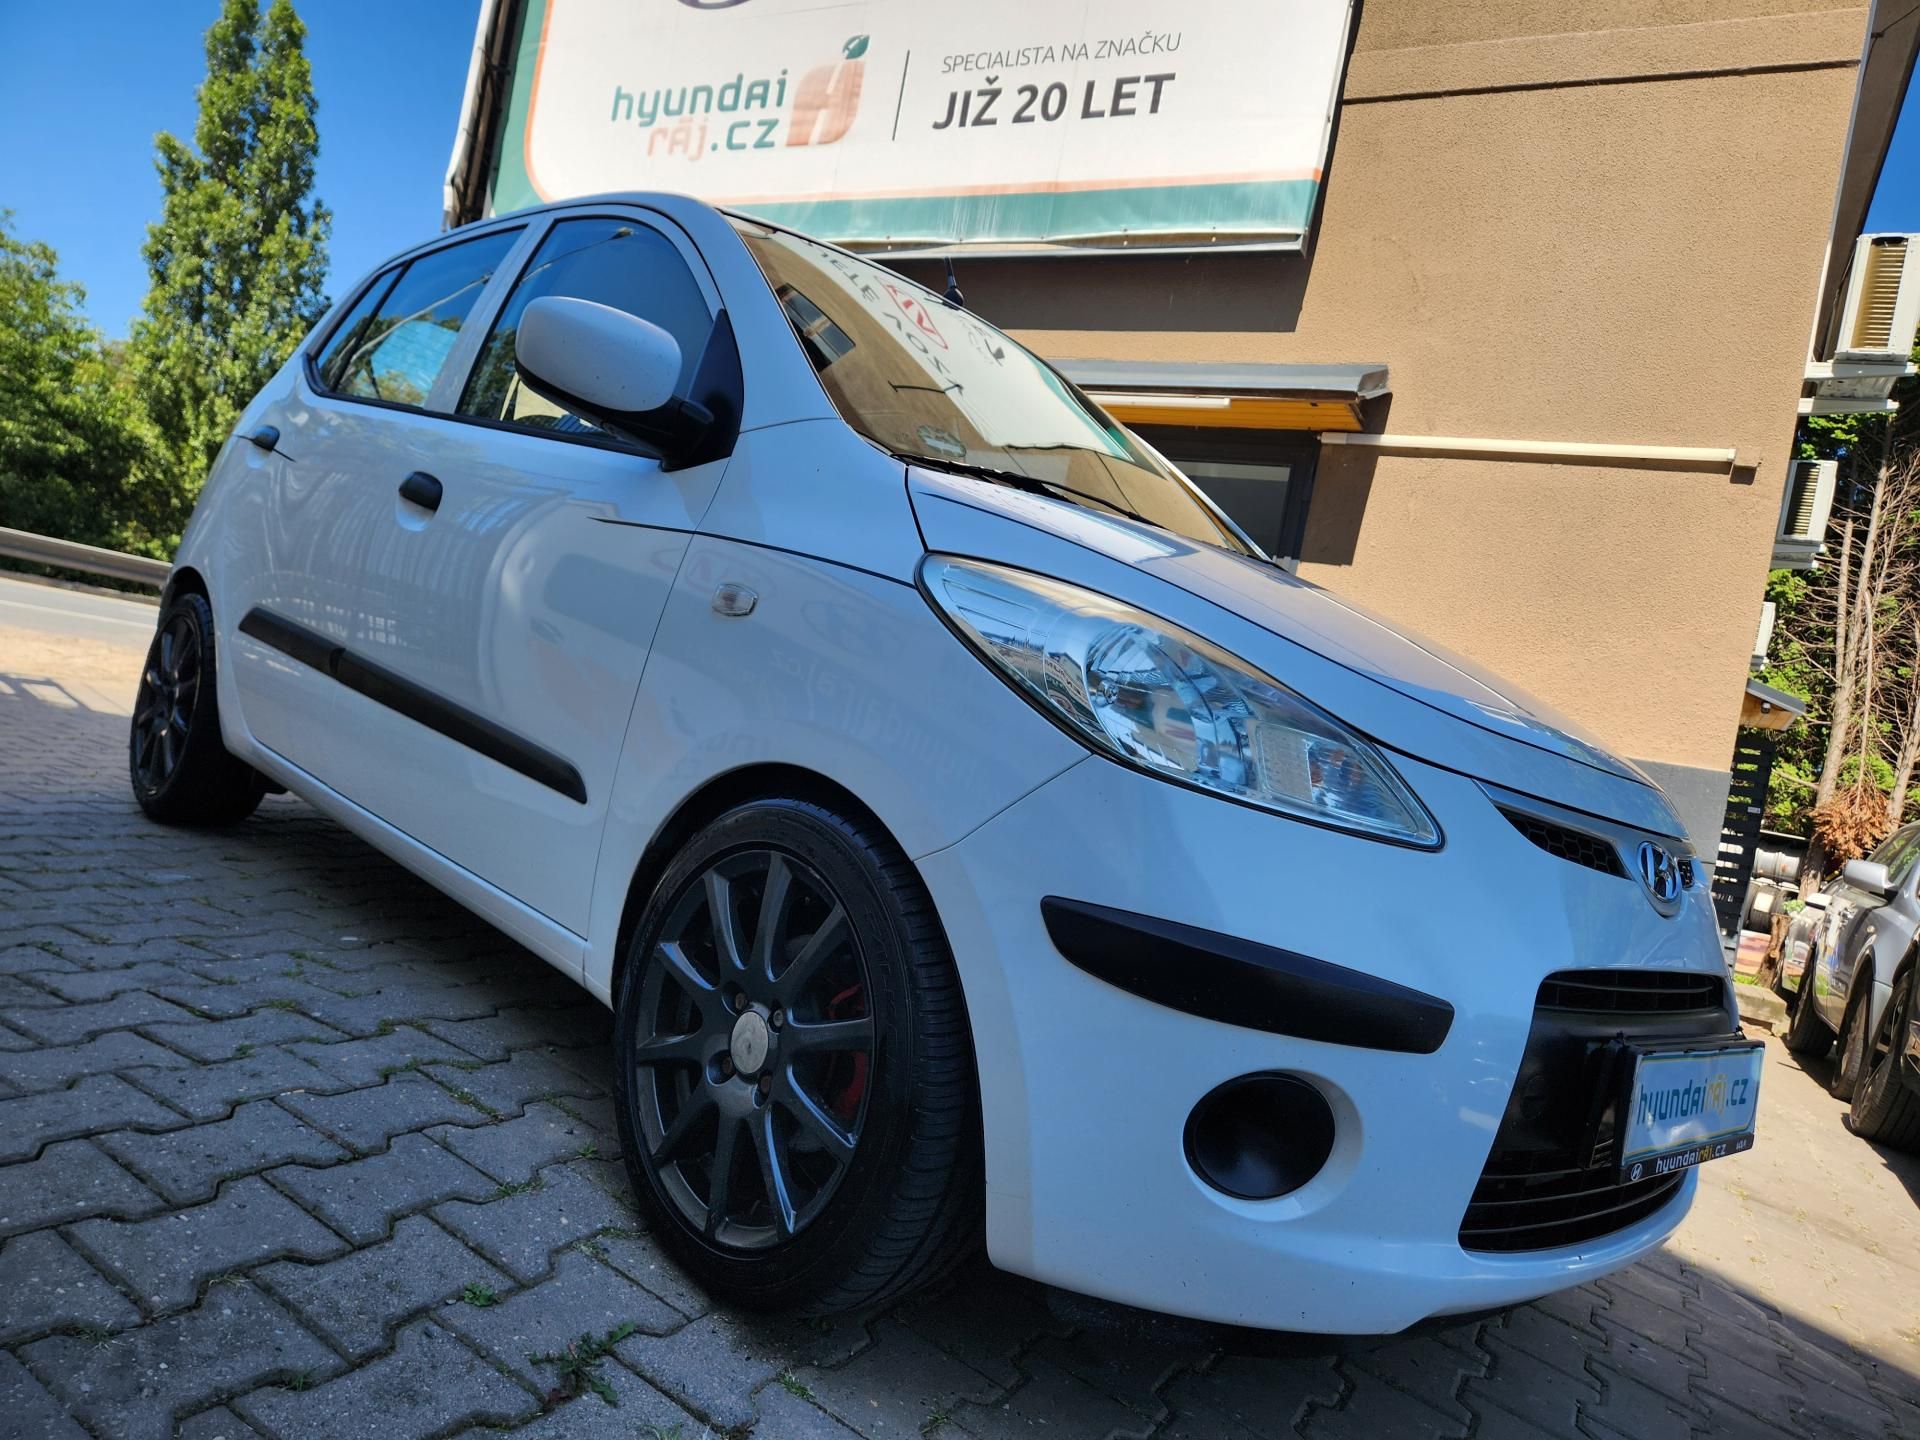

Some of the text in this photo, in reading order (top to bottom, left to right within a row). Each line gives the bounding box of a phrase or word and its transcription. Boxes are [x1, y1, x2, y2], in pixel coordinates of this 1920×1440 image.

[941, 30, 1182, 74] SPECIALISTA NA ZNAČKU
[611, 68, 788, 128] hyundai
[932, 72, 1176, 130] JIŽ 20 LET
